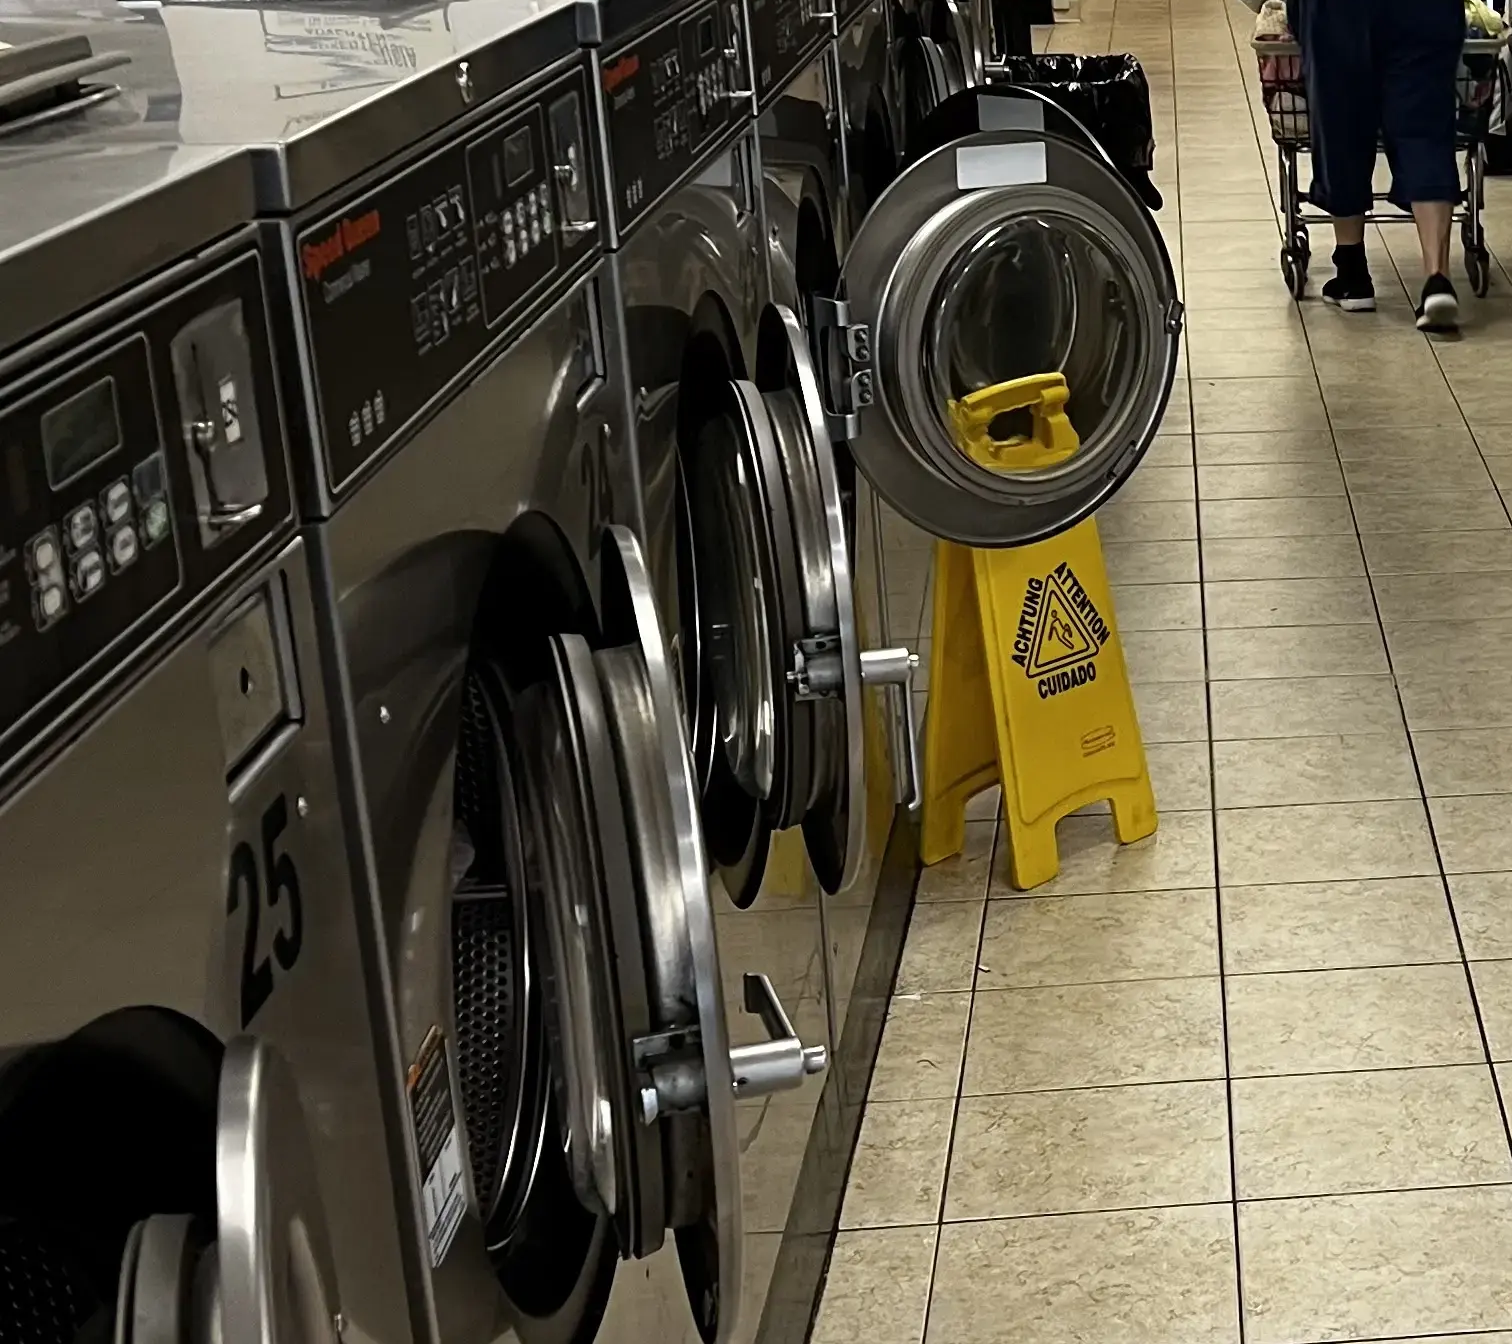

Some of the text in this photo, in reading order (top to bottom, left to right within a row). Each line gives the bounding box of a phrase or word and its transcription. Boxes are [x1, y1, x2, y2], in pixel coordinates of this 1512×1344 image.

[1011, 577, 1044, 667] ACHTUNG
[1054, 561, 1110, 646] ATTENTION
[1038, 662, 1096, 699] CUIDADO
[226, 793, 301, 1031] 25
